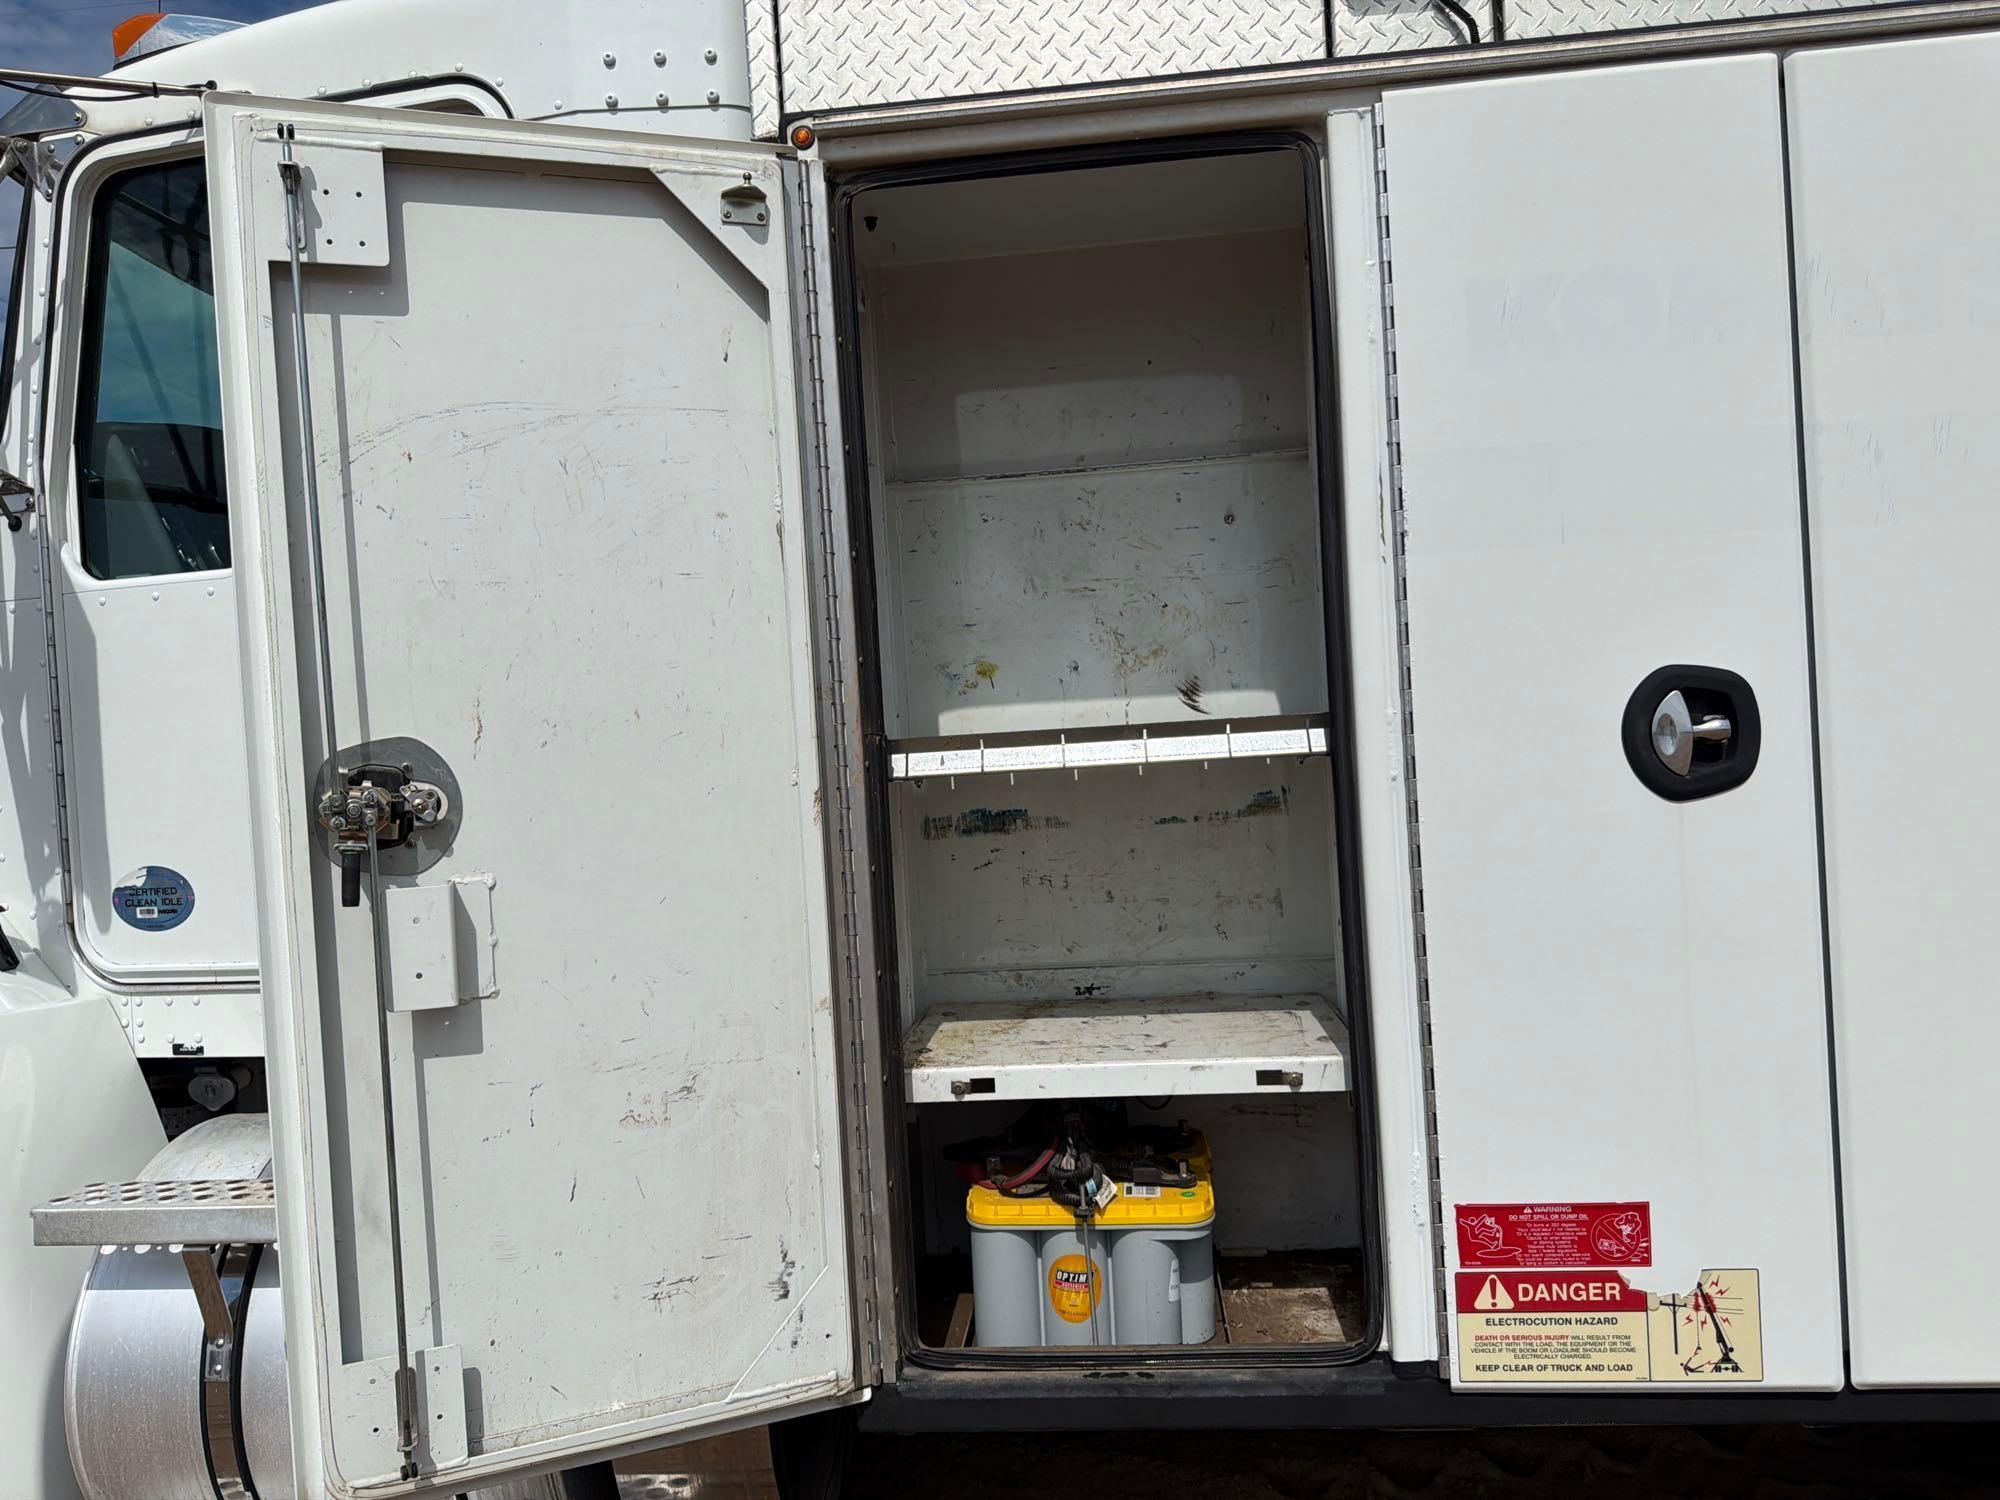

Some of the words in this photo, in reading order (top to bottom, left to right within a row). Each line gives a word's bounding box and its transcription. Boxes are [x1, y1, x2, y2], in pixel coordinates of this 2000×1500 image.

[128, 887, 177, 896] CERTIFIED
[125, 898, 157, 908] CLEAN
[161, 897, 183, 906] IDLE
[1056, 1270, 1088, 1283] OPTIM
[1517, 1282, 1621, 1302] DANGER
[1485, 1317, 1573, 1326] ELECTROCUTION
[1575, 1317, 1618, 1326] HAZARD
[1475, 1364, 1500, 1372] KEEP
[1502, 1364, 1534, 1372] CLEAR
[1536, 1364, 1549, 1372] OF
[1551, 1364, 1583, 1372] TRUCK
[1584, 1364, 1605, 1372] AND
[1607, 1364, 1633, 1372] LOAD
